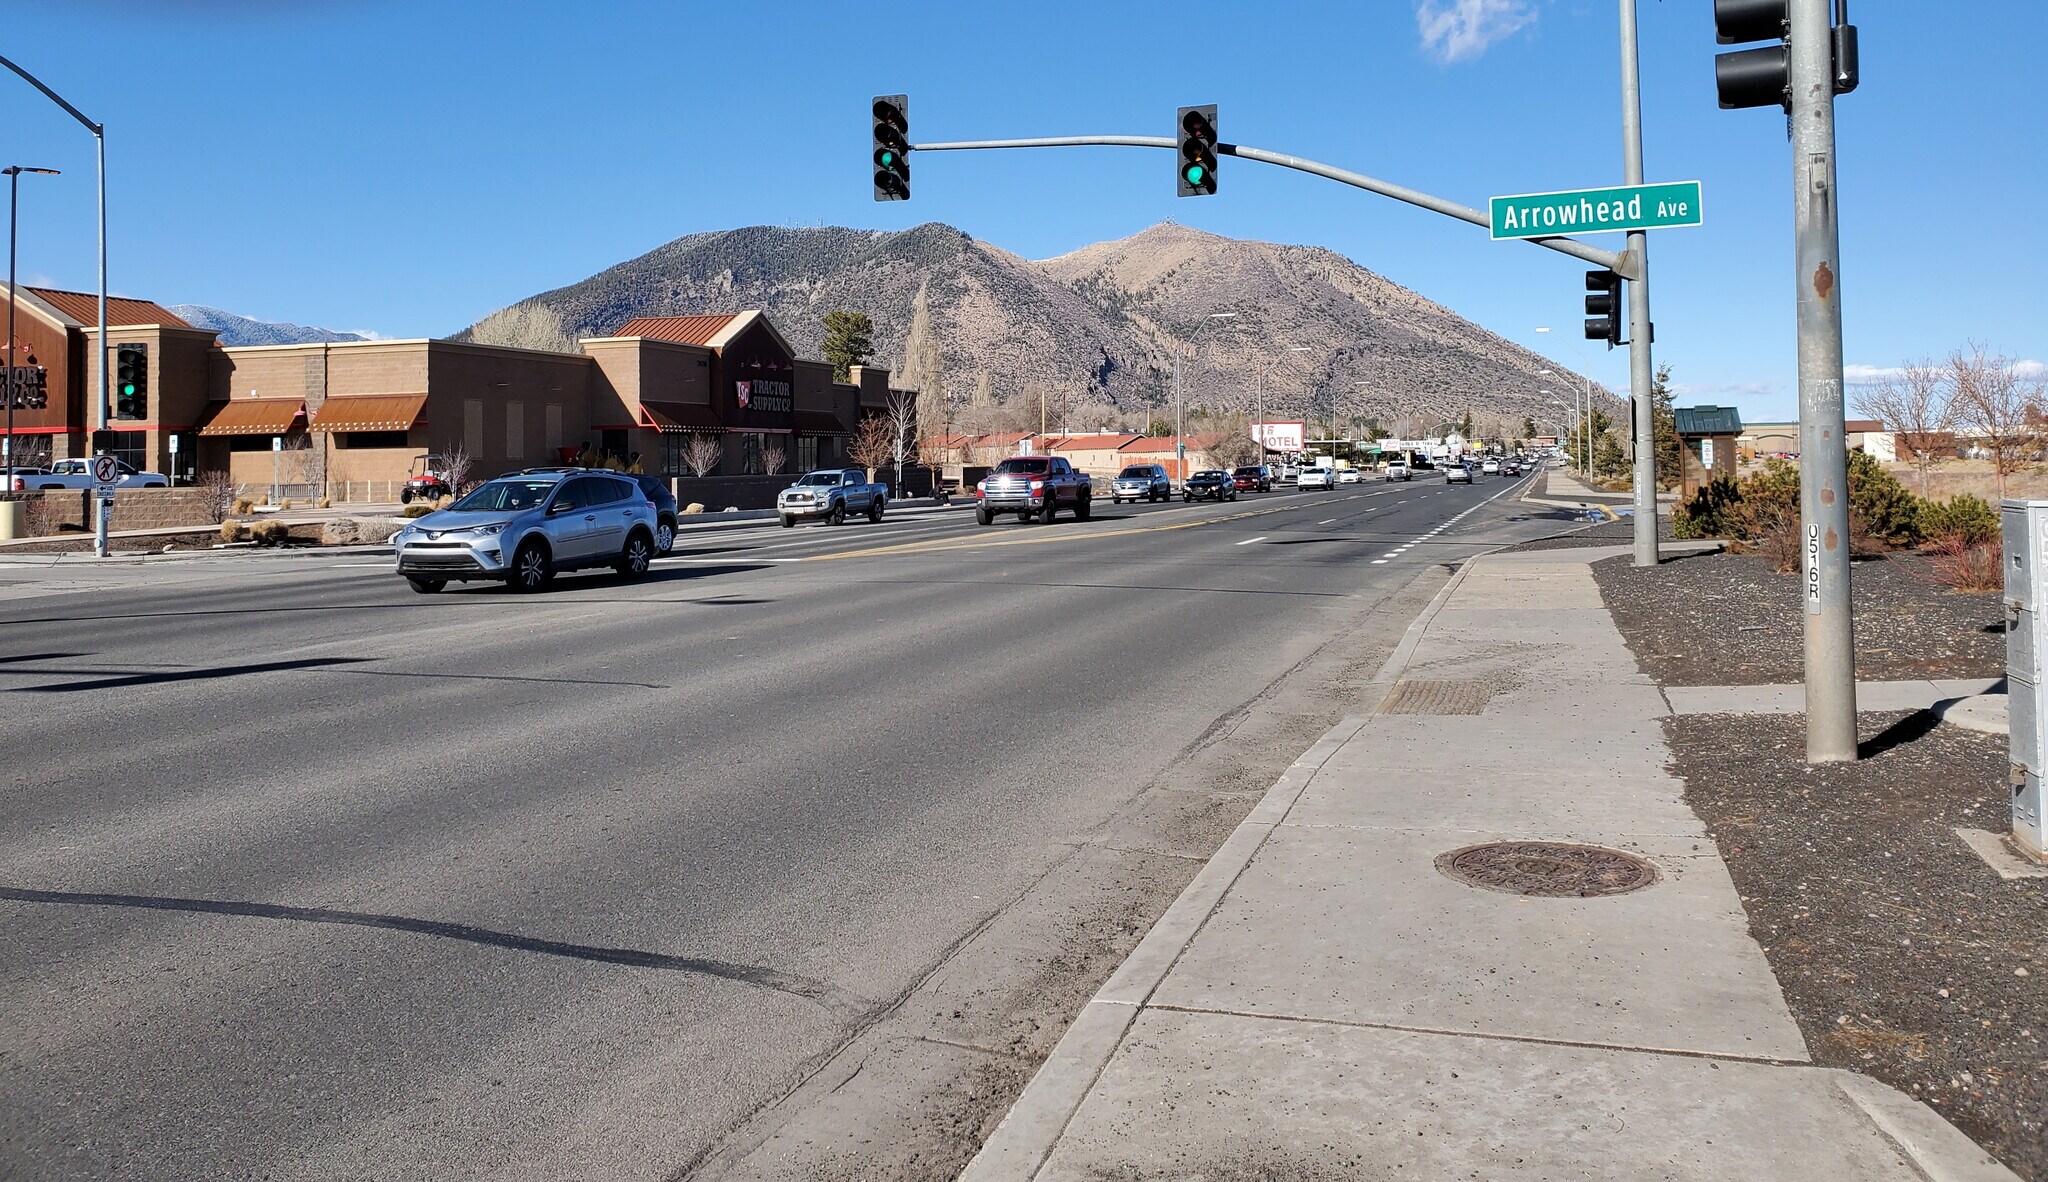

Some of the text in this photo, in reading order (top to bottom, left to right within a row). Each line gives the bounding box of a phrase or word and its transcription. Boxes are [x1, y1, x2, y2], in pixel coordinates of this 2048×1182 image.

[1504, 194, 1688, 229] Arrowhead Ave
[737, 382, 749, 404] TSC
[753, 379, 790, 396] TRACTOR
[753, 396, 781, 411] SUPPLY
[1258, 437, 1298, 446] MOTEL
